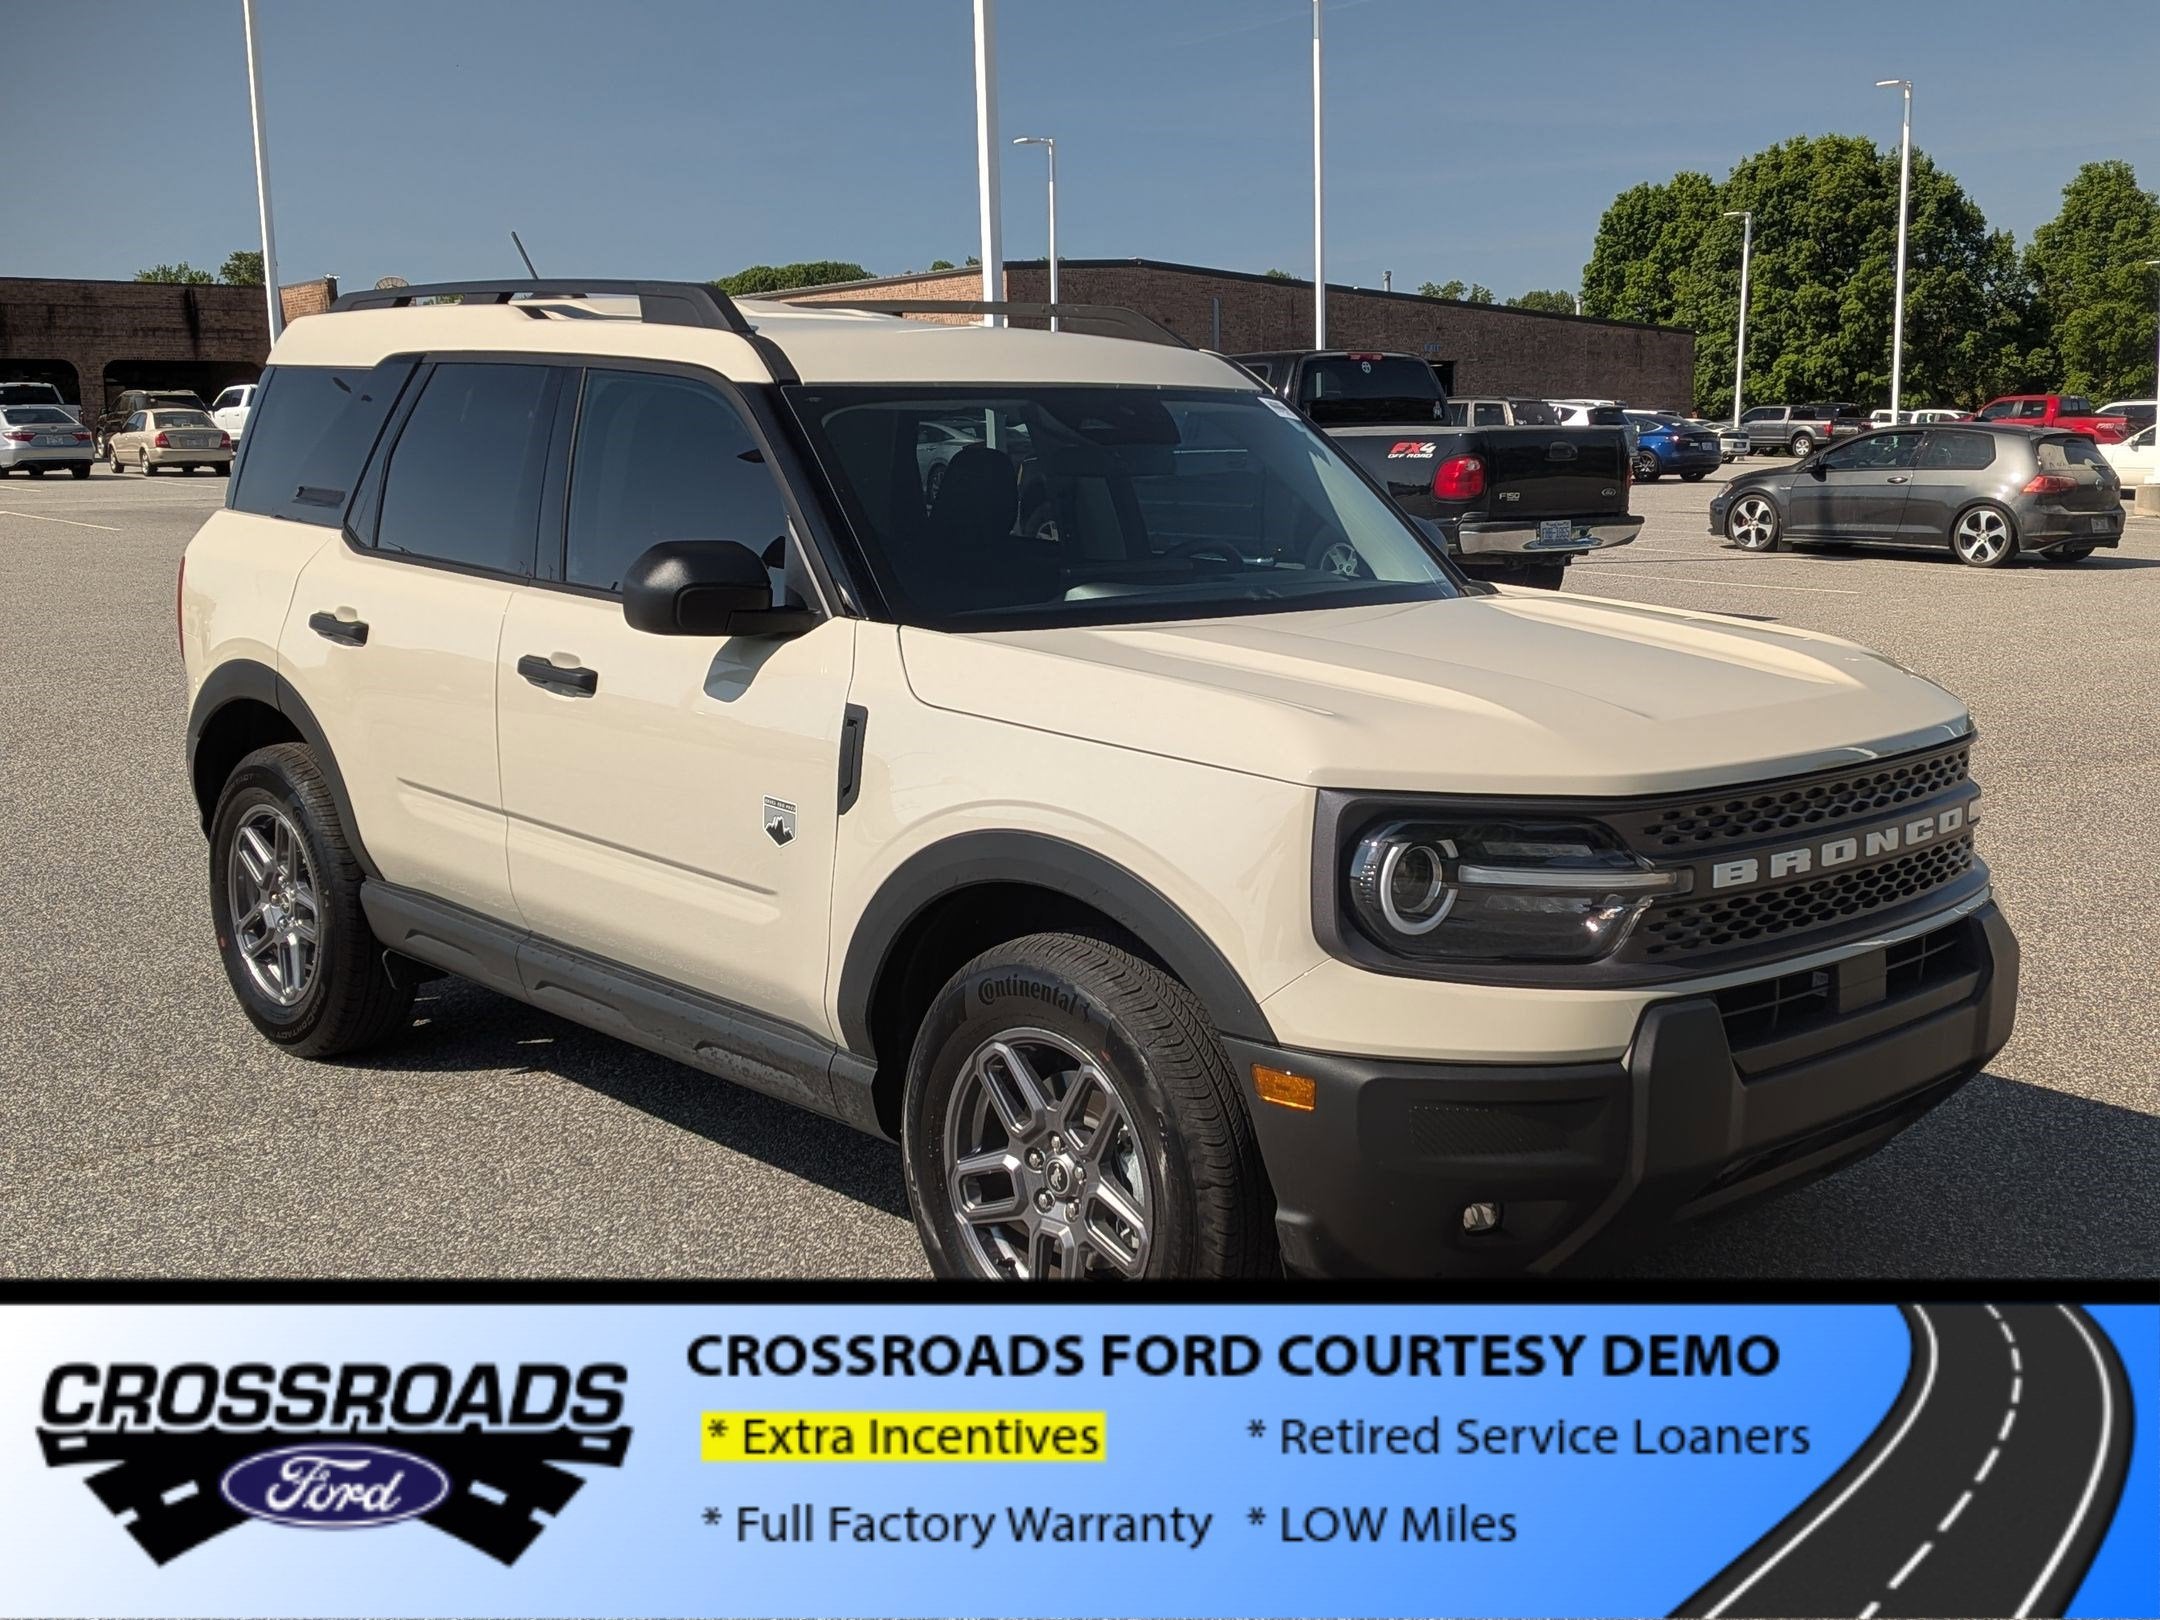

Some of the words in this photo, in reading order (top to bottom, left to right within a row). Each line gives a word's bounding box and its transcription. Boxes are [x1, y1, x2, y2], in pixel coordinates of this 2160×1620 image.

[1390, 441, 1437, 454] FX4
[1712, 807, 1963, 889] BRONCO
[977, 973, 1080, 1016] Continental
